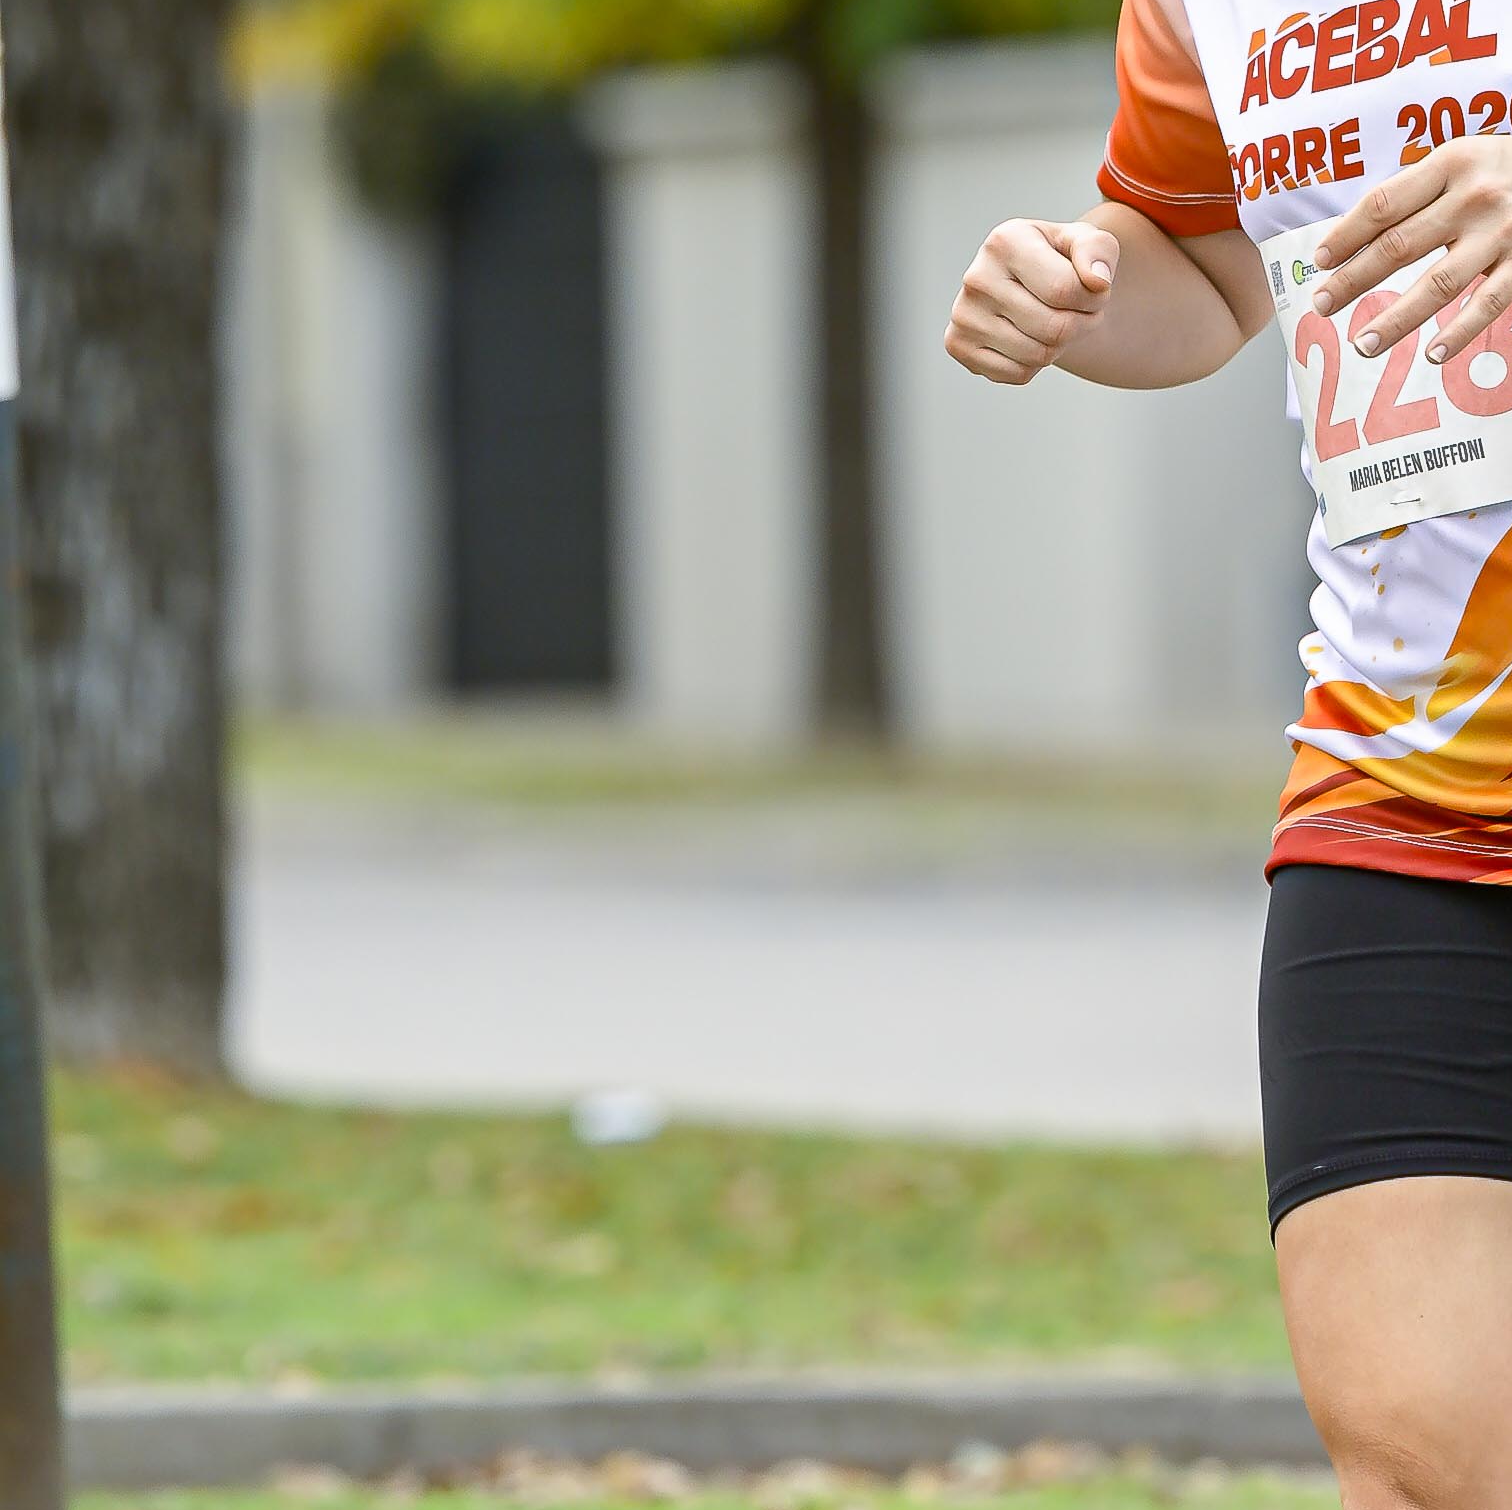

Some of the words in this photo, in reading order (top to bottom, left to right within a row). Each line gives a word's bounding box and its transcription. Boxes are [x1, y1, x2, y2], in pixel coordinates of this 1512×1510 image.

[1349, 464, 1383, 492] MARIA
[1382, 457, 1424, 482] BELEN
[1424, 438, 1486, 471] BUFFONI
